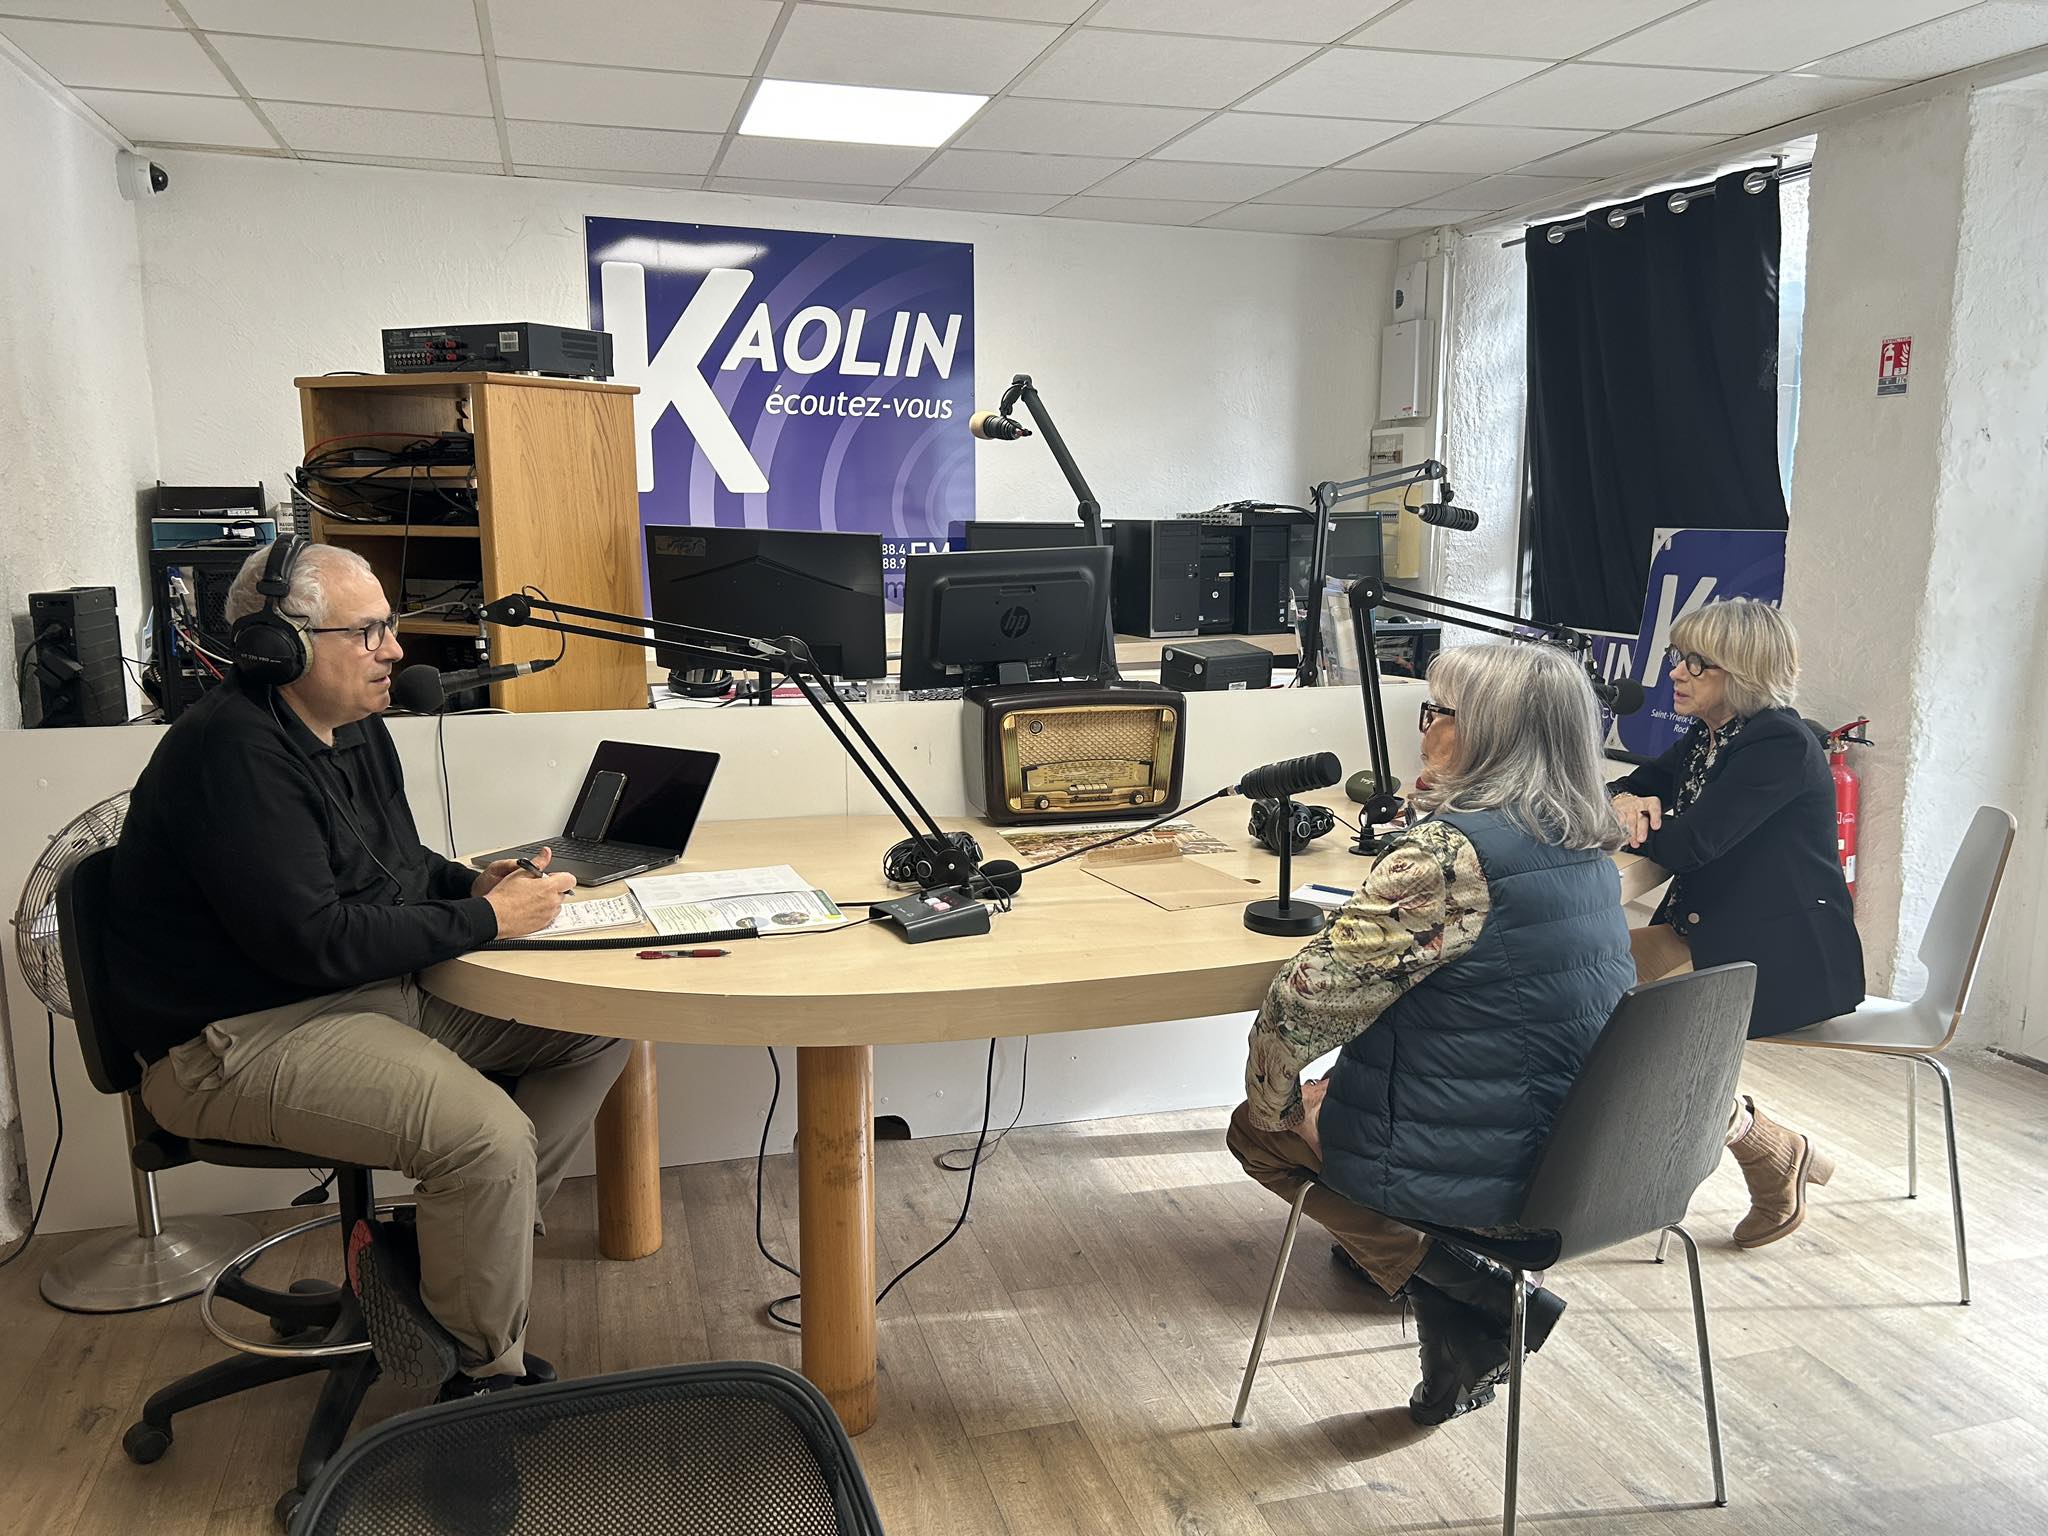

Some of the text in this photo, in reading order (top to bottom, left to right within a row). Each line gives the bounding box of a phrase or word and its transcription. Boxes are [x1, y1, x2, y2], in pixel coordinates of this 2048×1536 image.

[601, 261, 962, 494] KAOLIN
[765, 384, 953, 420] écoutez-vous
[882, 543, 906, 555] 88.4
[882, 557, 907, 570] 88.9
